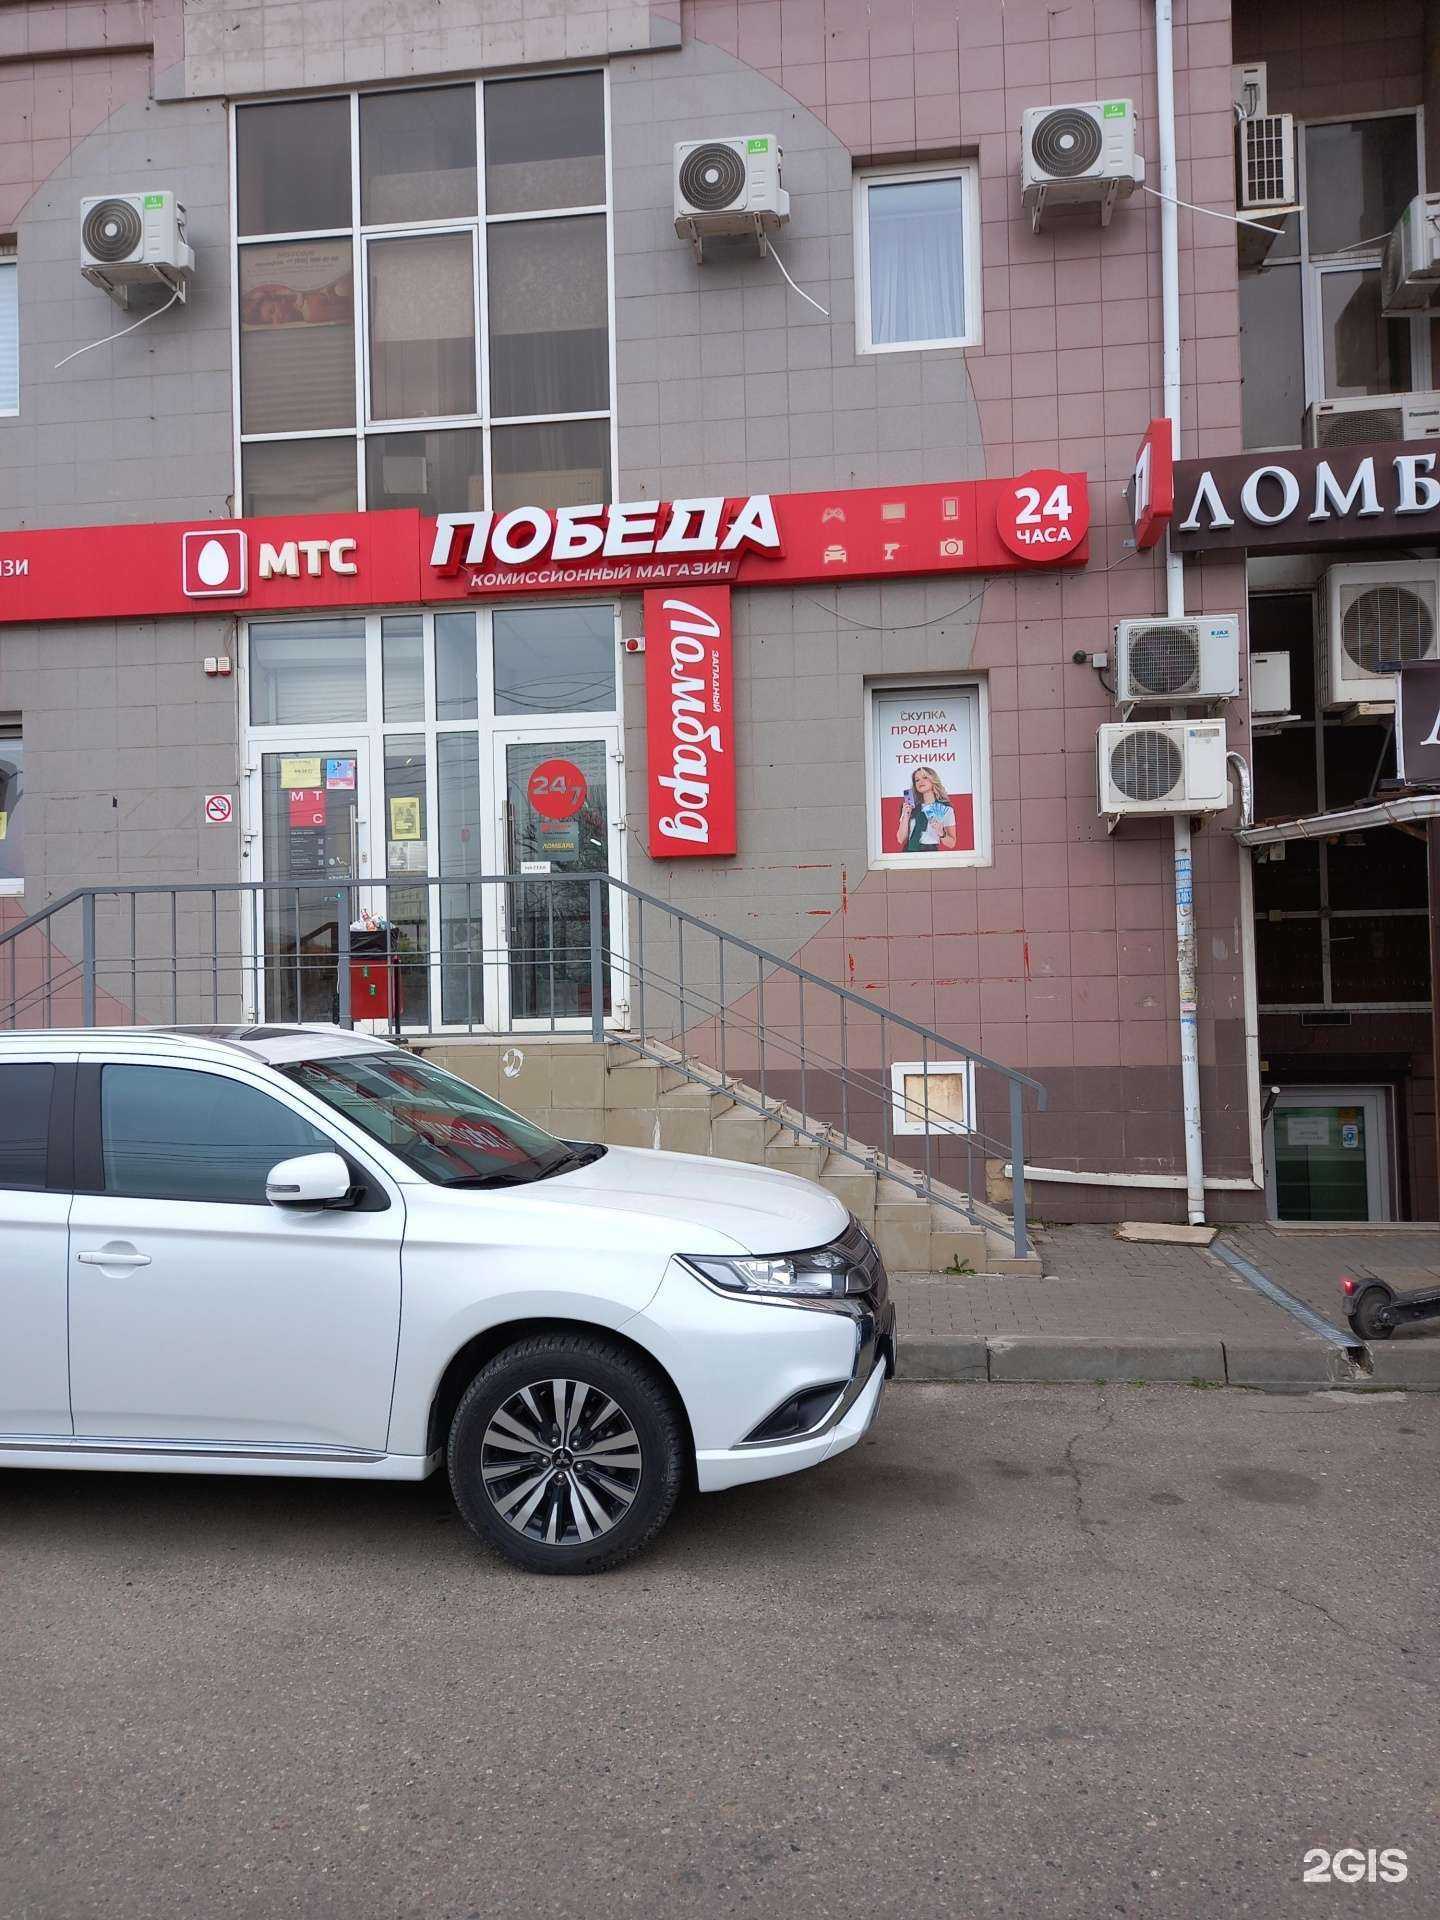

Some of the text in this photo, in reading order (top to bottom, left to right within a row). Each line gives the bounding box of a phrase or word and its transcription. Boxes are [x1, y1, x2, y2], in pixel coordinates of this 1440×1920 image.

[1014, 485, 1072, 524] 24
[430, 495, 780, 565] ПОБЕДА
[1016, 526, 1072, 544] ЧАСА
[259, 538, 357, 579] МТС
[0, 559, 29, 577] ЗИ
[471, 561, 731, 587] КОМИССИОННЫЙ МАГАЗИН
[657, 599, 723, 843] Ломбард
[900, 710, 946, 721] СКУПКА
[891, 723, 957, 736] ПРОДАЖА
[902, 738, 948, 750] ОБМЕН
[896, 752, 956, 764] ТЕХНИКИ
